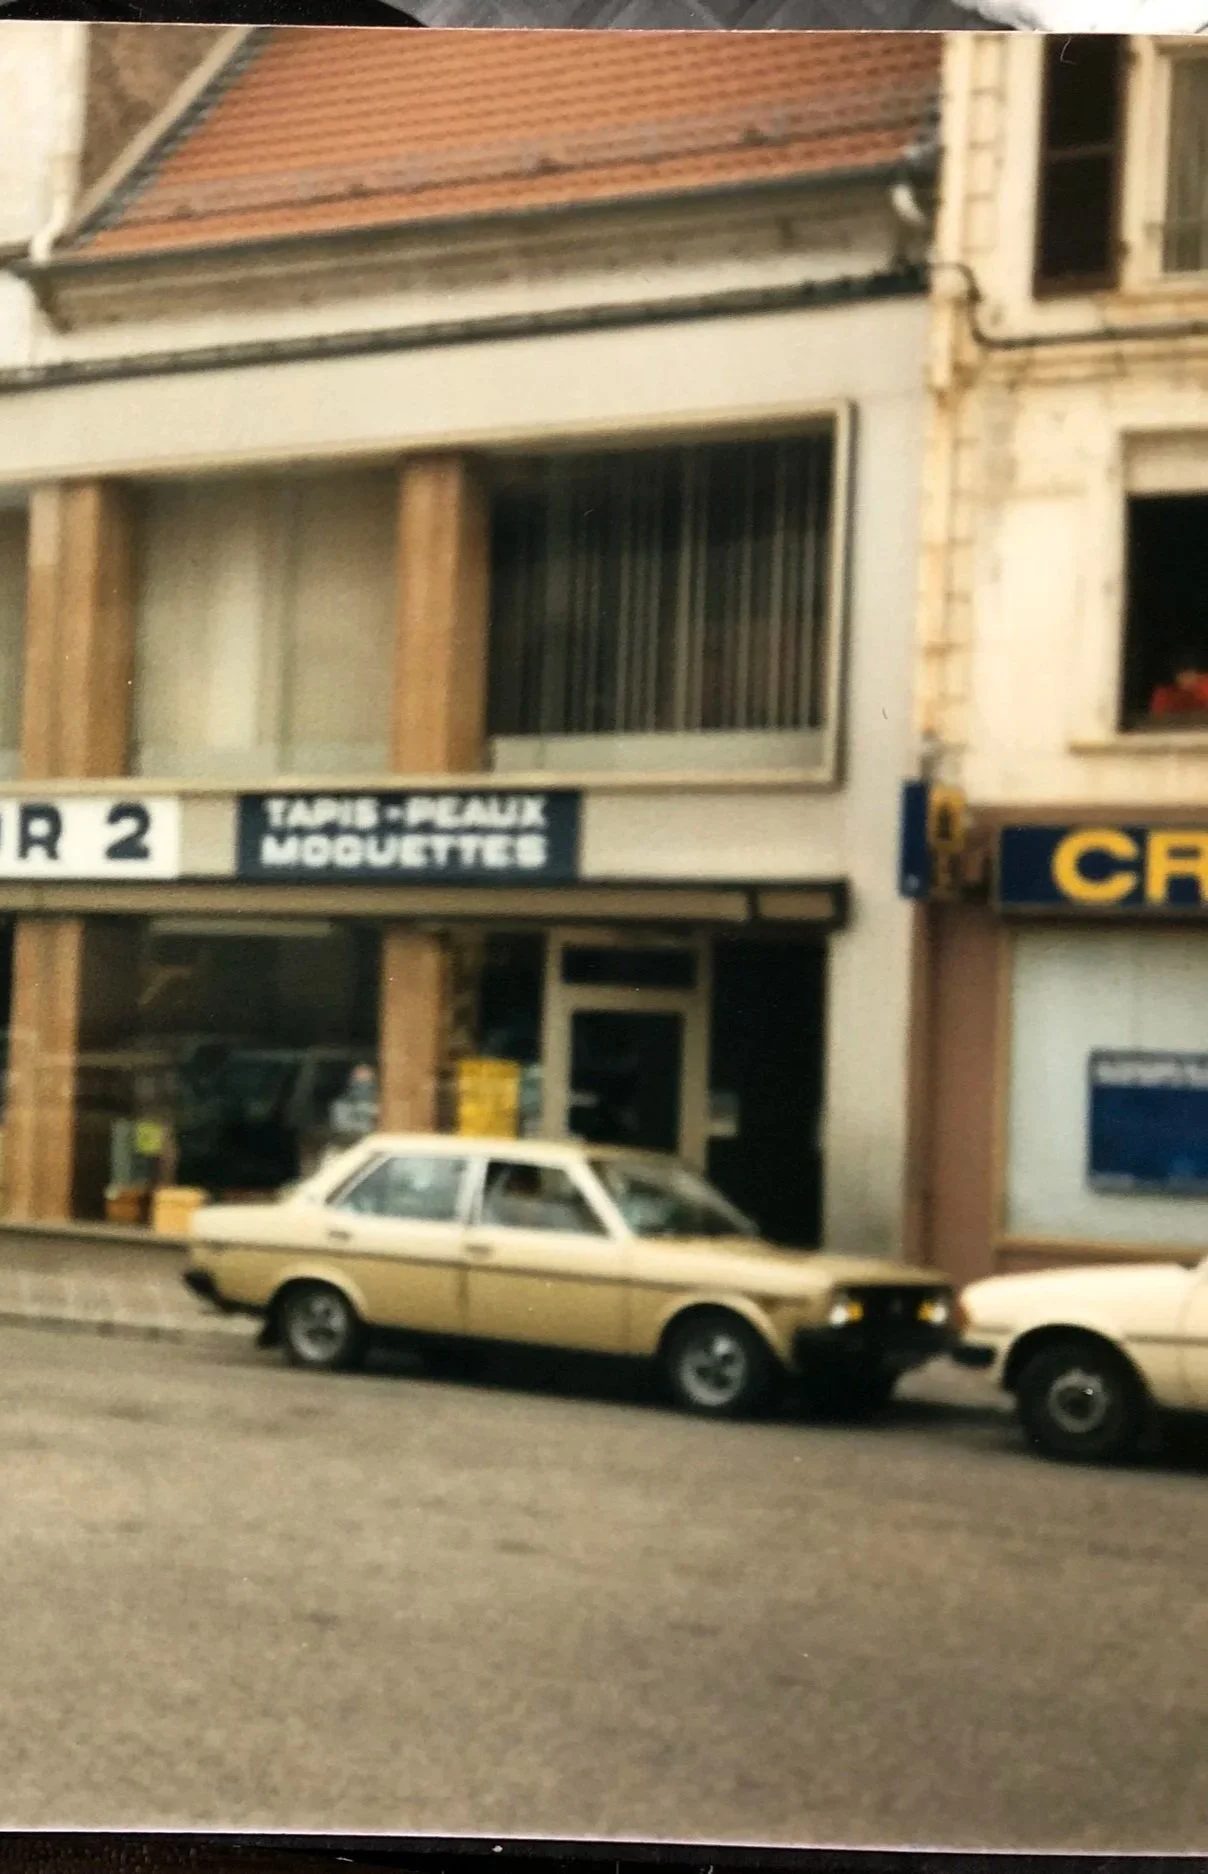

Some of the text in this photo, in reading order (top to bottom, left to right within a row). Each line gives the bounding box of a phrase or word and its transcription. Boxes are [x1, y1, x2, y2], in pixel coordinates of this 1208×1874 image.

[106, 803, 150, 860] 2
[262, 834, 546, 869] MOQUETTES
[1051, 828, 1208, 904] CR
